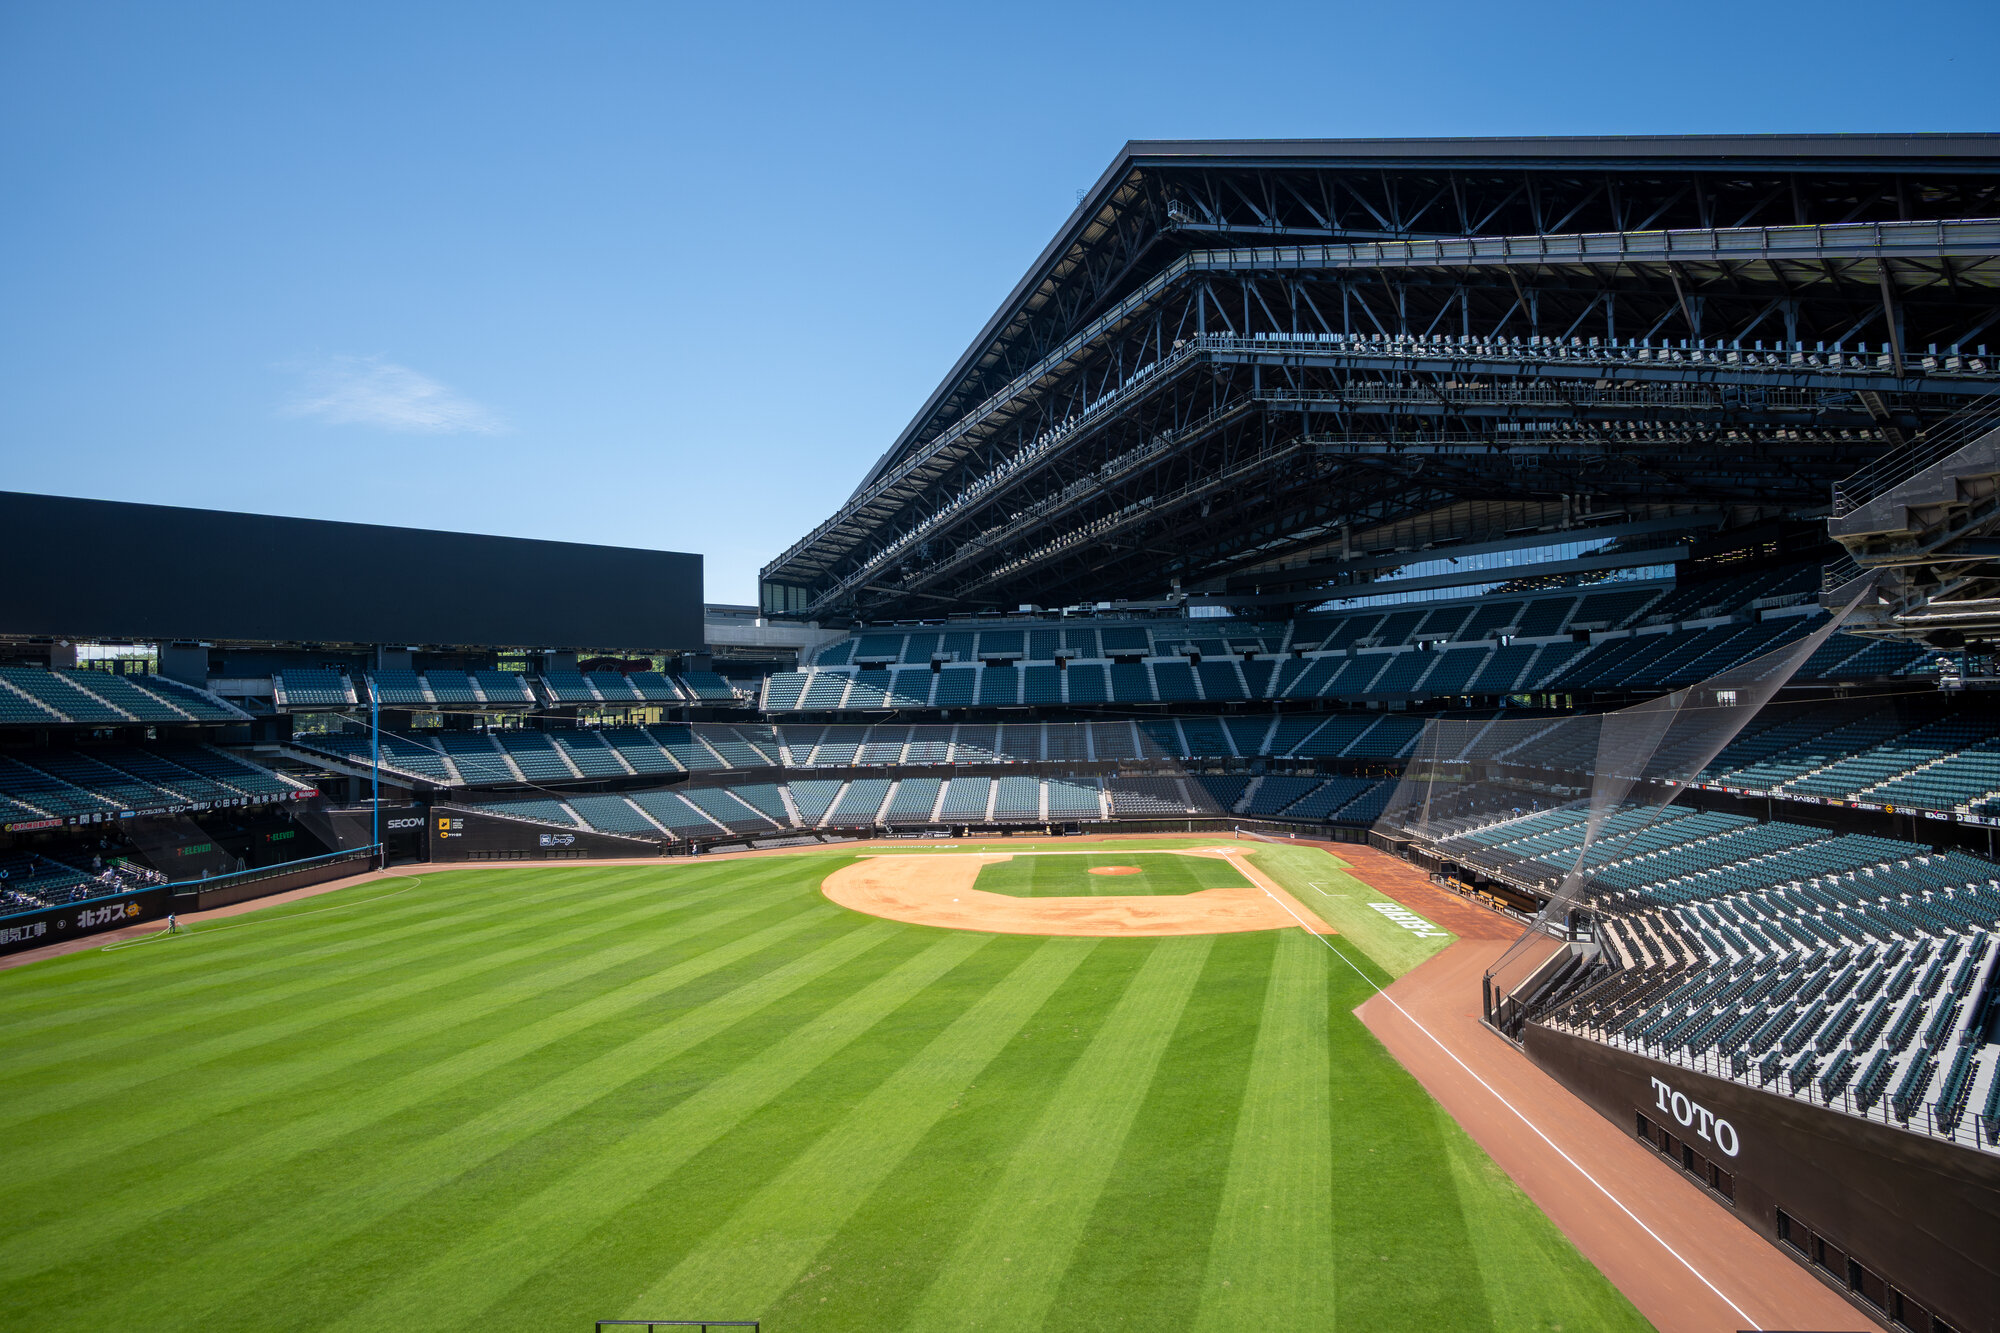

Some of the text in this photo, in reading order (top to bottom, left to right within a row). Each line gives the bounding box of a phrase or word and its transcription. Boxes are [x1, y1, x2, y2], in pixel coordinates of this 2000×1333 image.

[388, 818, 424, 829] SECOM
[77, 903, 126, 928] 北ガス
[1651, 1076, 1739, 1157] TOTO
